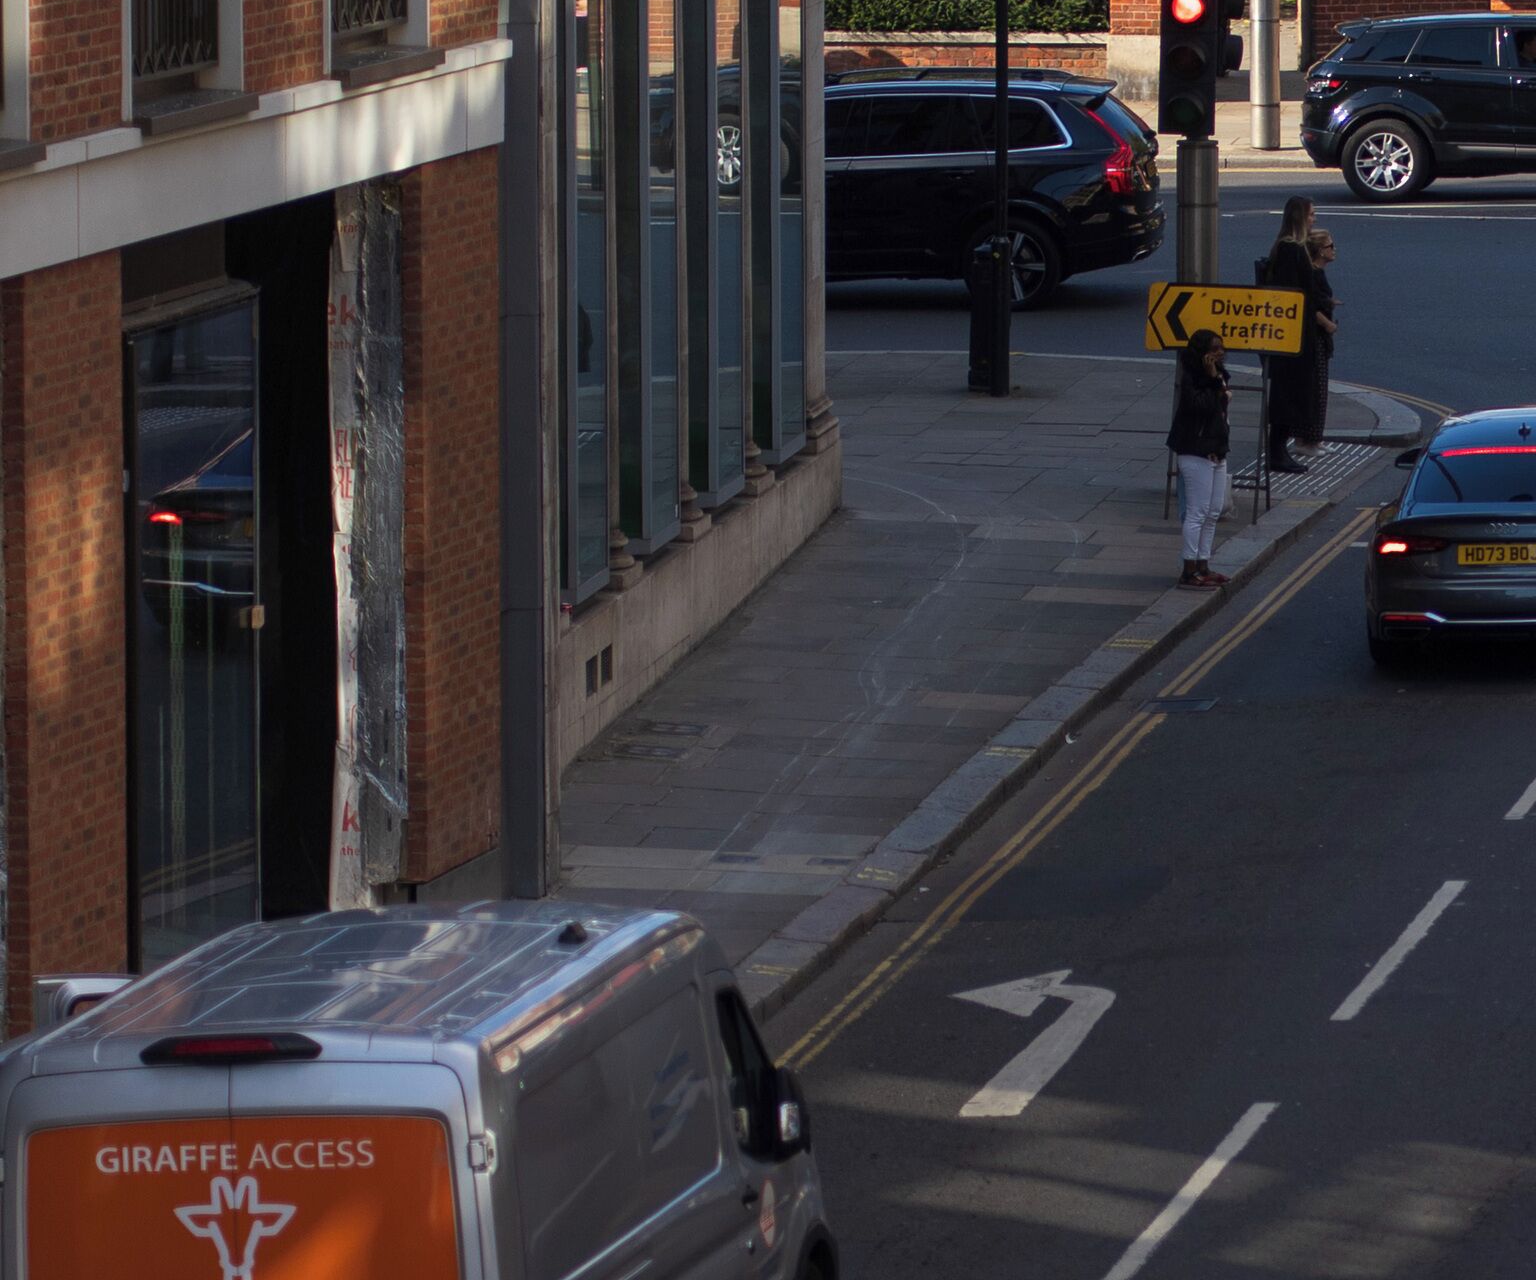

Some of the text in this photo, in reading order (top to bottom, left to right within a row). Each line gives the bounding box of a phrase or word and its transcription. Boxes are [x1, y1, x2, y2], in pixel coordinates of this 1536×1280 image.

[1211, 299, 1298, 320] Diverted
[1220, 322, 1286, 340] traffic
[1465, 546, 1505, 562] HD73
[95, 1140, 375, 1173] GIRAFFE ACCESS
